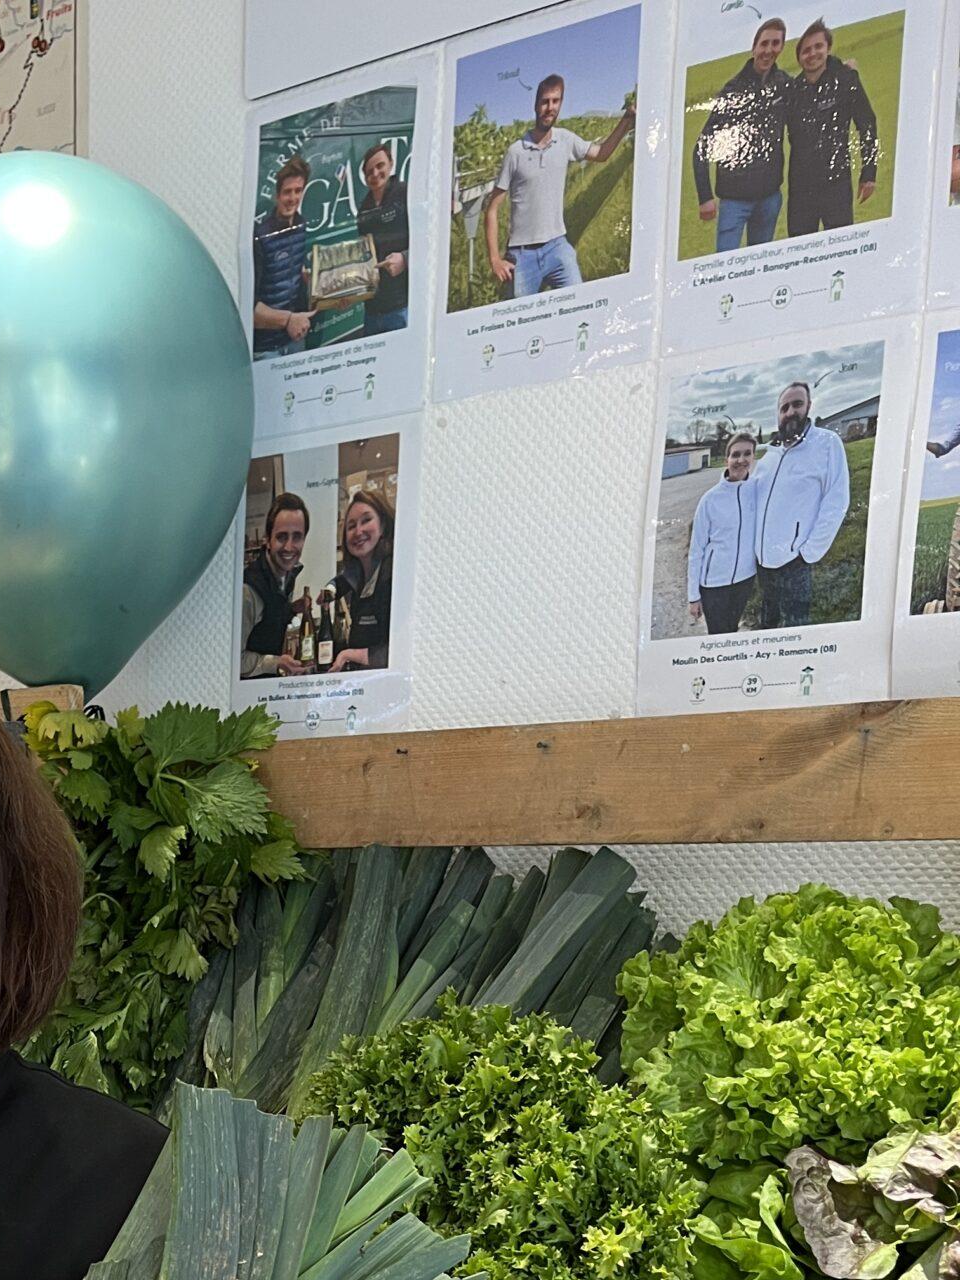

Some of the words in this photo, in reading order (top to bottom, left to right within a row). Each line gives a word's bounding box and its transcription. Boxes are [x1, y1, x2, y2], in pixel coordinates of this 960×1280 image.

[692, 259, 725, 273] Famille
[491, 301, 536, 317] Producteur
[548, 292, 576, 305] Fraises
[480, 322, 505, 333] Fraises
[700, 638, 749, 652] Agriculteurs
[751, 637, 761, 646] et
[763, 633, 802, 645] meuniers
[672, 656, 699, 667] Moulin
[700, 655, 715, 664] Des
[716, 651, 748, 663] Courtils
[755, 650, 771, 660] Acy
[778, 646, 818, 657] Romance
[820, 643, 837, 655] (08)
[747, 677, 758, 686] 39
